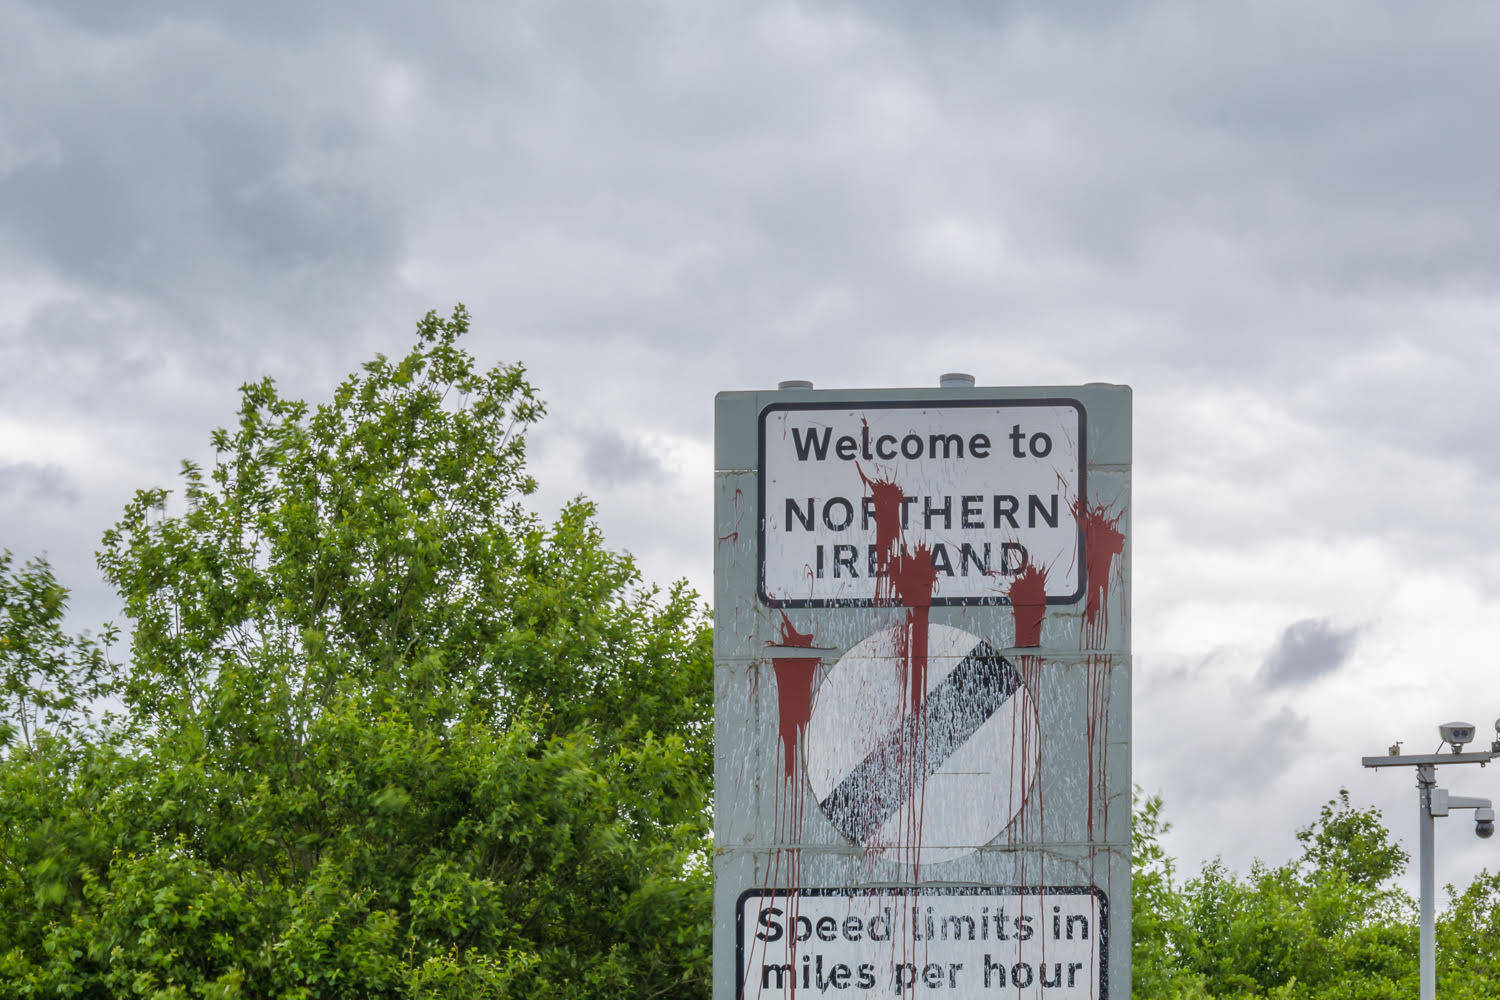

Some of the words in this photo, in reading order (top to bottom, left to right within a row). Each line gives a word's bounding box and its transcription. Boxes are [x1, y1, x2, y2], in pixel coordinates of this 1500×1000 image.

[791, 426, 991, 461] Welcome
[1009, 424, 1053, 459] to
[816, 542, 1030, 578] IREAND
[756, 906, 893, 947] Speed
[912, 906, 1034, 941] limits
[1053, 905, 1089, 940] in
[761, 954, 877, 991] miles
[894, 962, 963, 996] per
[984, 954, 1083, 990] hour
